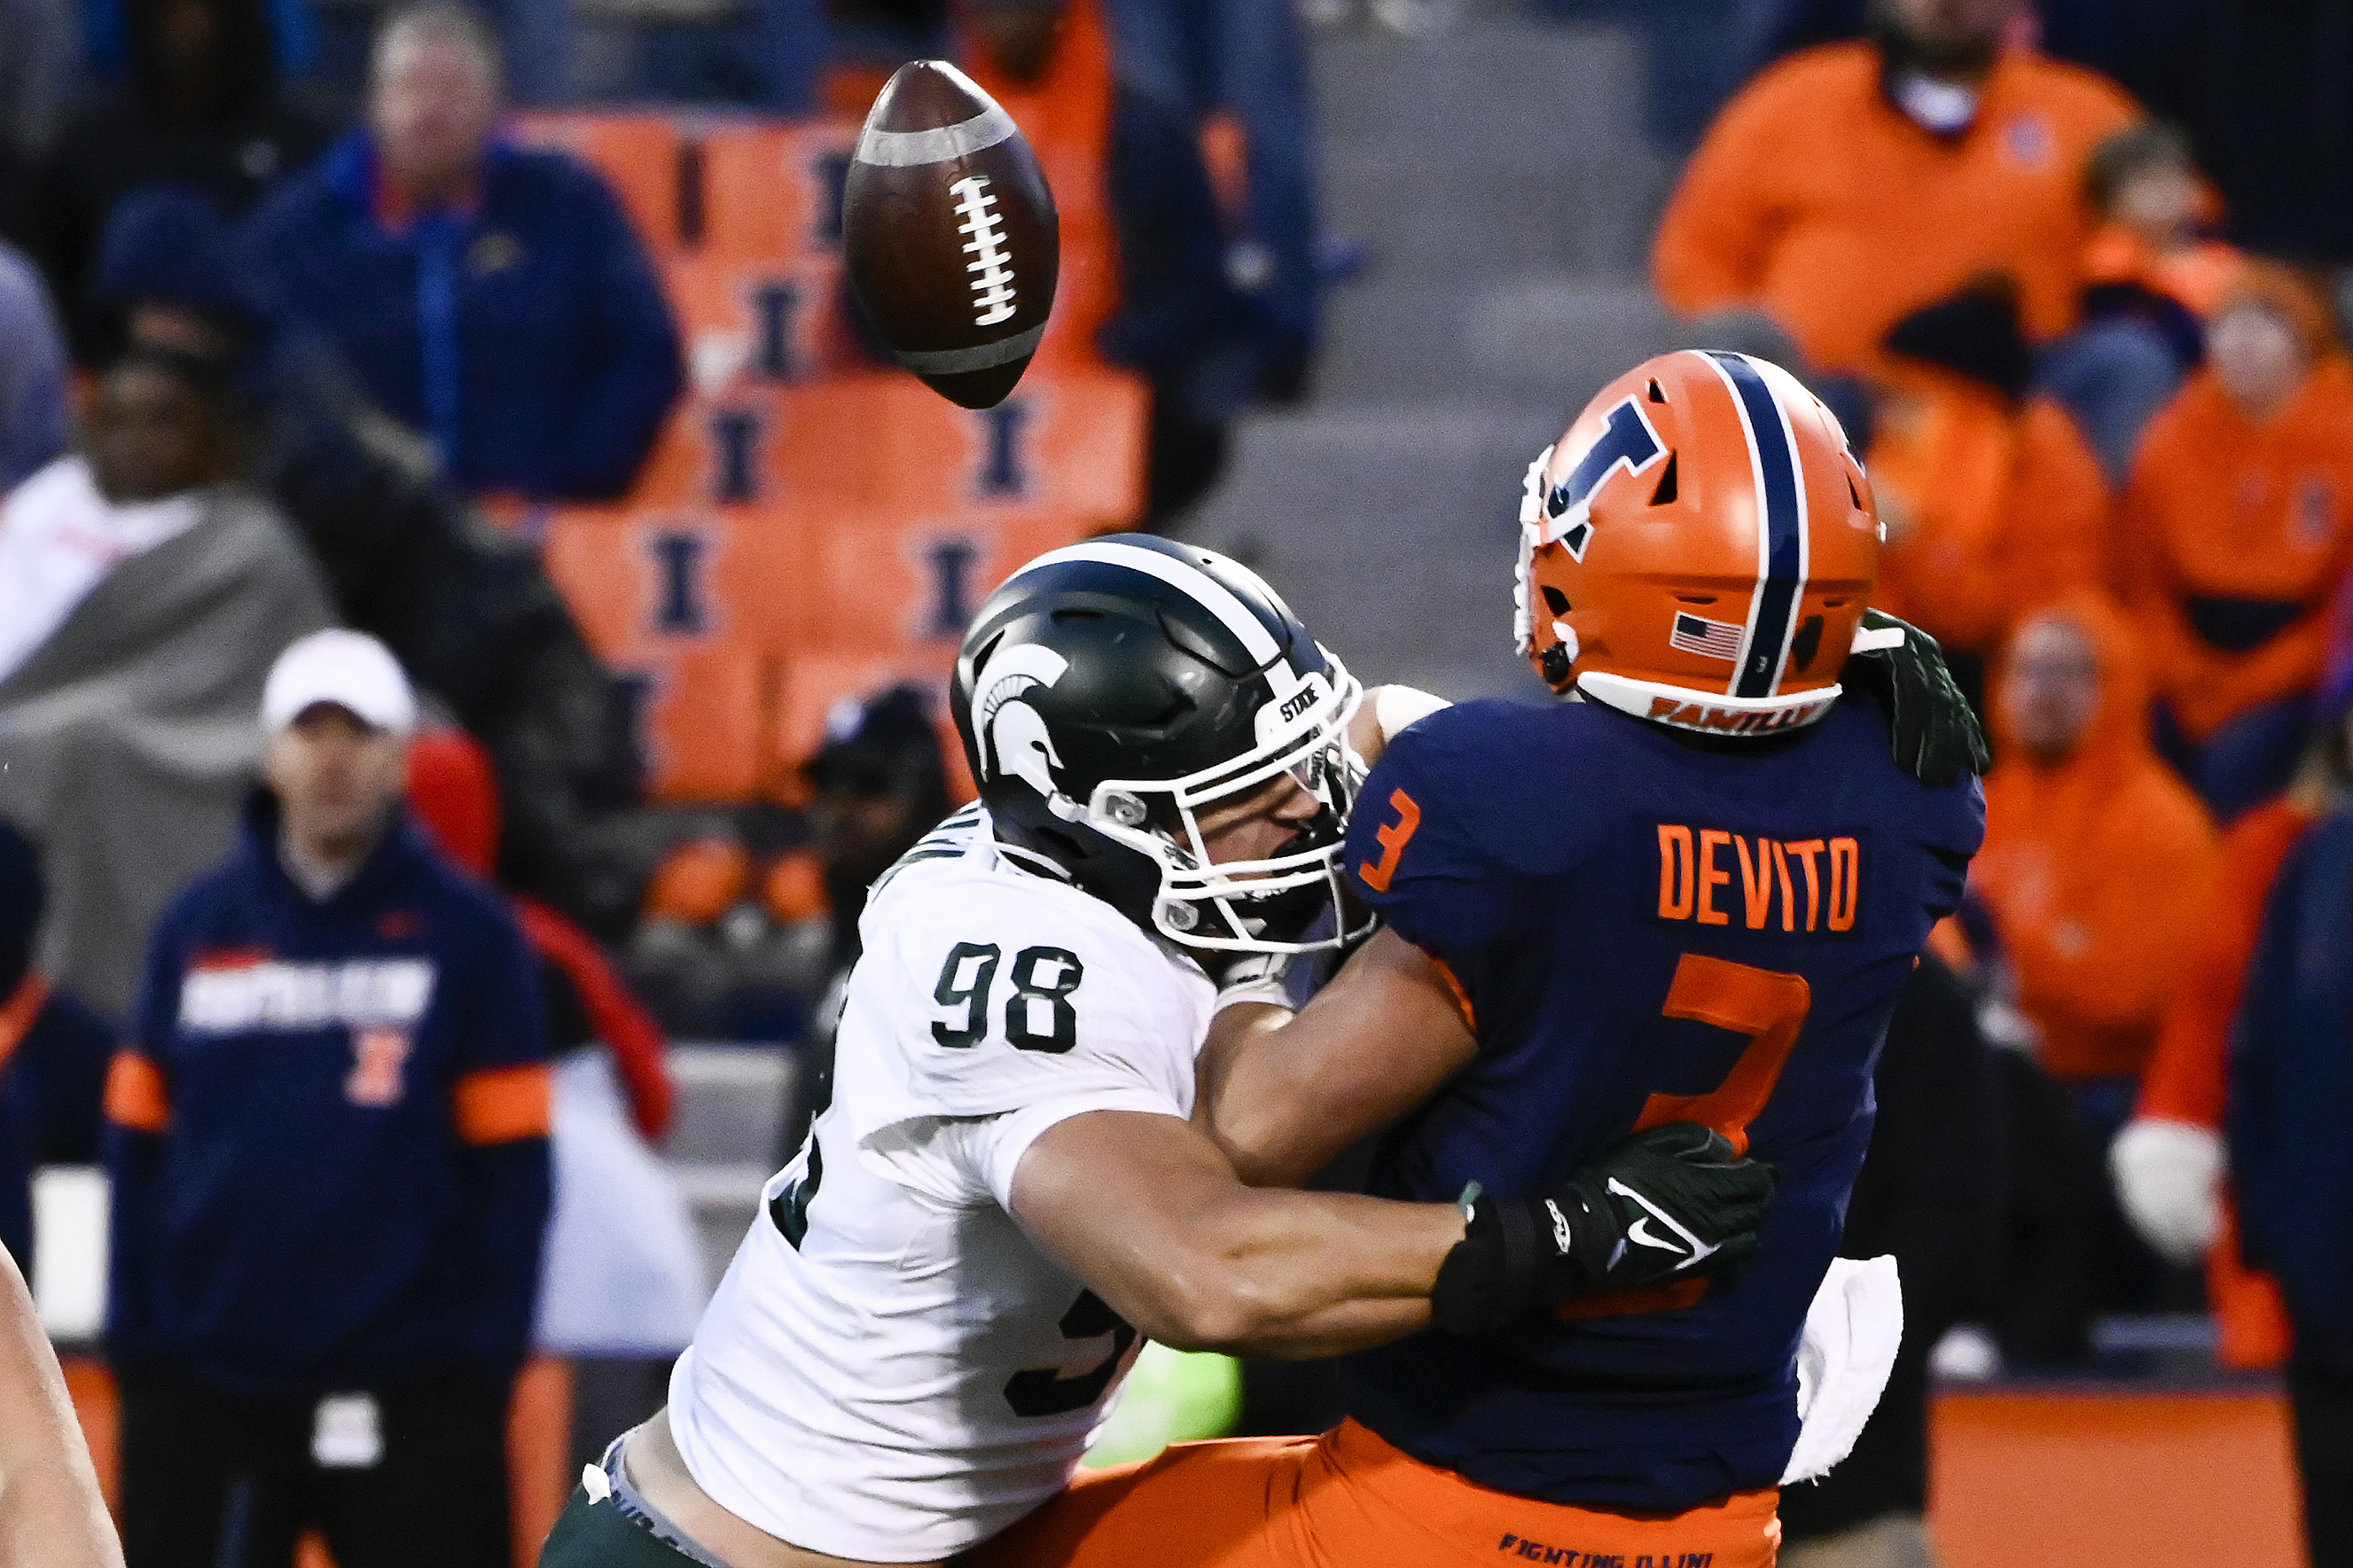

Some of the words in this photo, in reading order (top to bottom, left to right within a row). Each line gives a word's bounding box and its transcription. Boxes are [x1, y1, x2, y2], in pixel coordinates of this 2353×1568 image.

[1358, 787, 1421, 892] 3
[1657, 823, 1859, 932] DEVITO
[931, 941, 1083, 1054] 98
